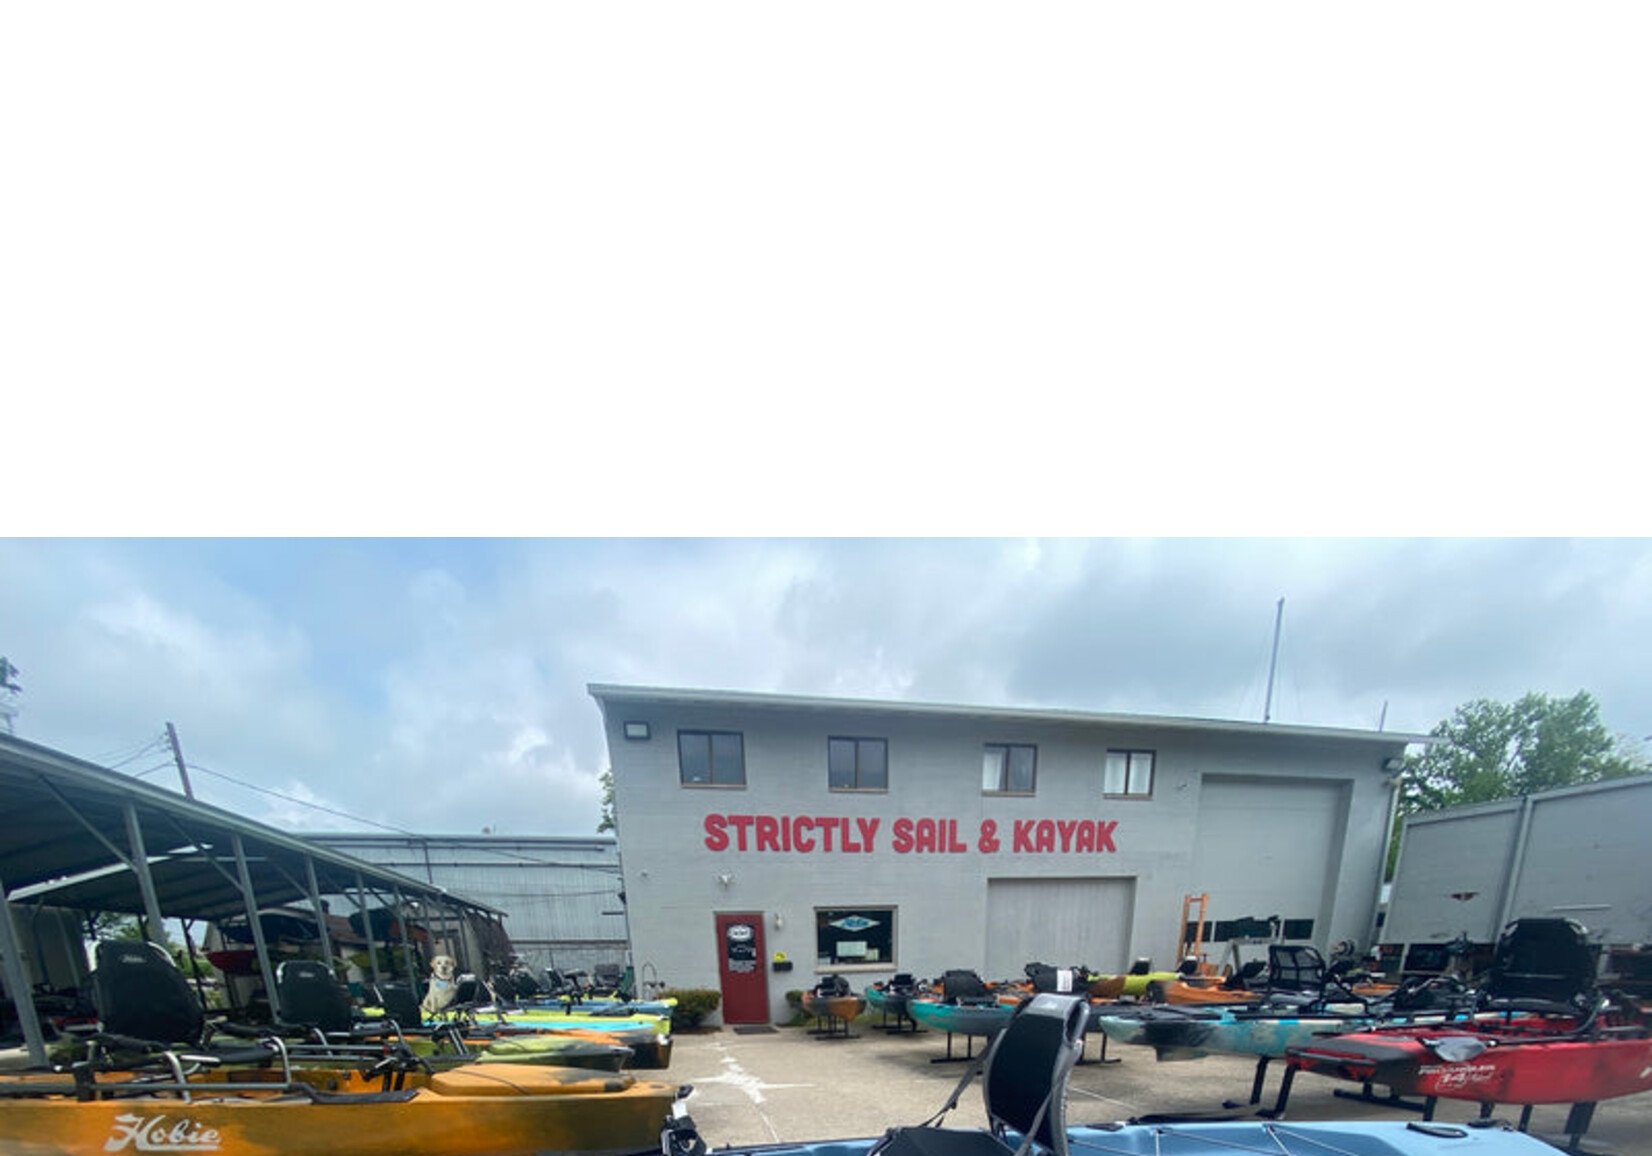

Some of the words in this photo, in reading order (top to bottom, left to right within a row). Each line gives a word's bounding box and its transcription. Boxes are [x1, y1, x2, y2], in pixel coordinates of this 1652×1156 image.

[704, 814, 880, 853] STRICTLY
[892, 817, 967, 853] SAIL
[978, 819, 1000, 853] &
[1013, 819, 1119, 853] KAYAK
[103, 1113, 221, 1151] Hobie
